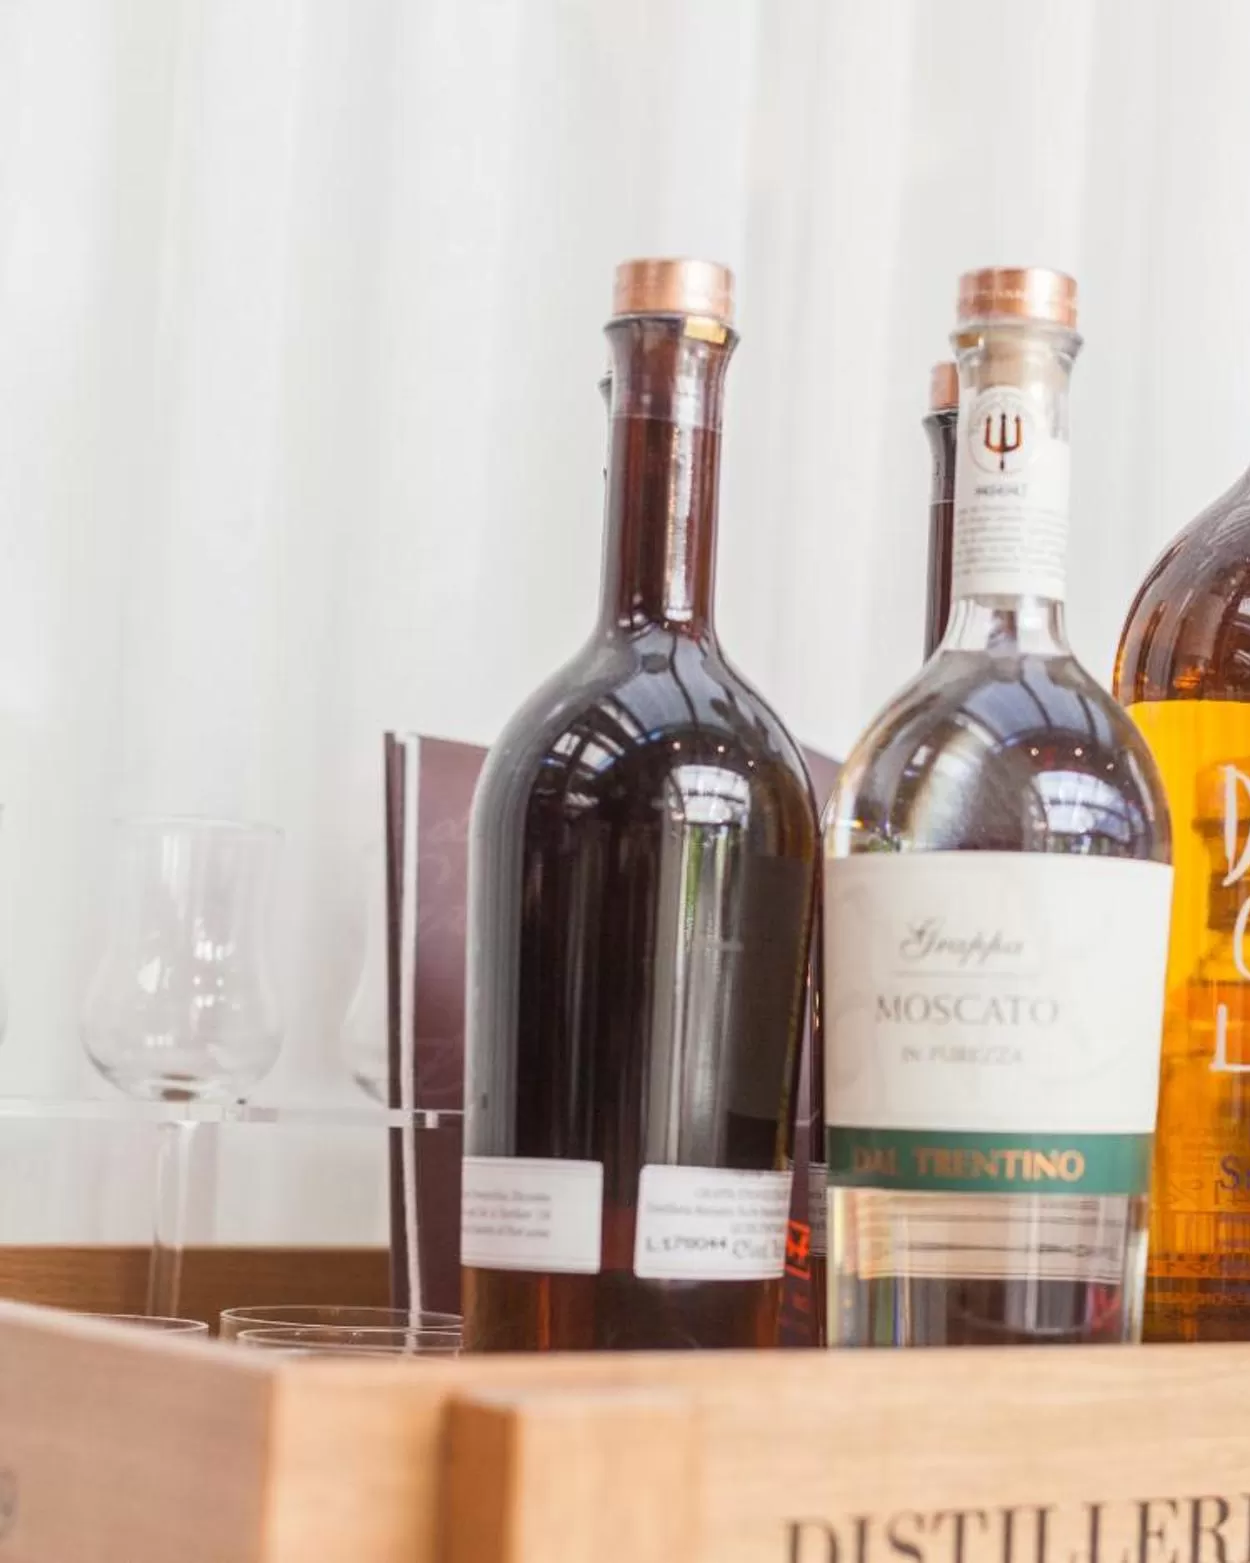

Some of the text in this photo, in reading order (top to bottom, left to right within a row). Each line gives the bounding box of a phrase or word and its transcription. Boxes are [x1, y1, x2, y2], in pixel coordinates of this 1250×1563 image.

[899, 916, 1025, 967] Grappa
[874, 993, 1059, 1026] MOSCATO
[912, 1147, 1086, 1182] TRENTINO
